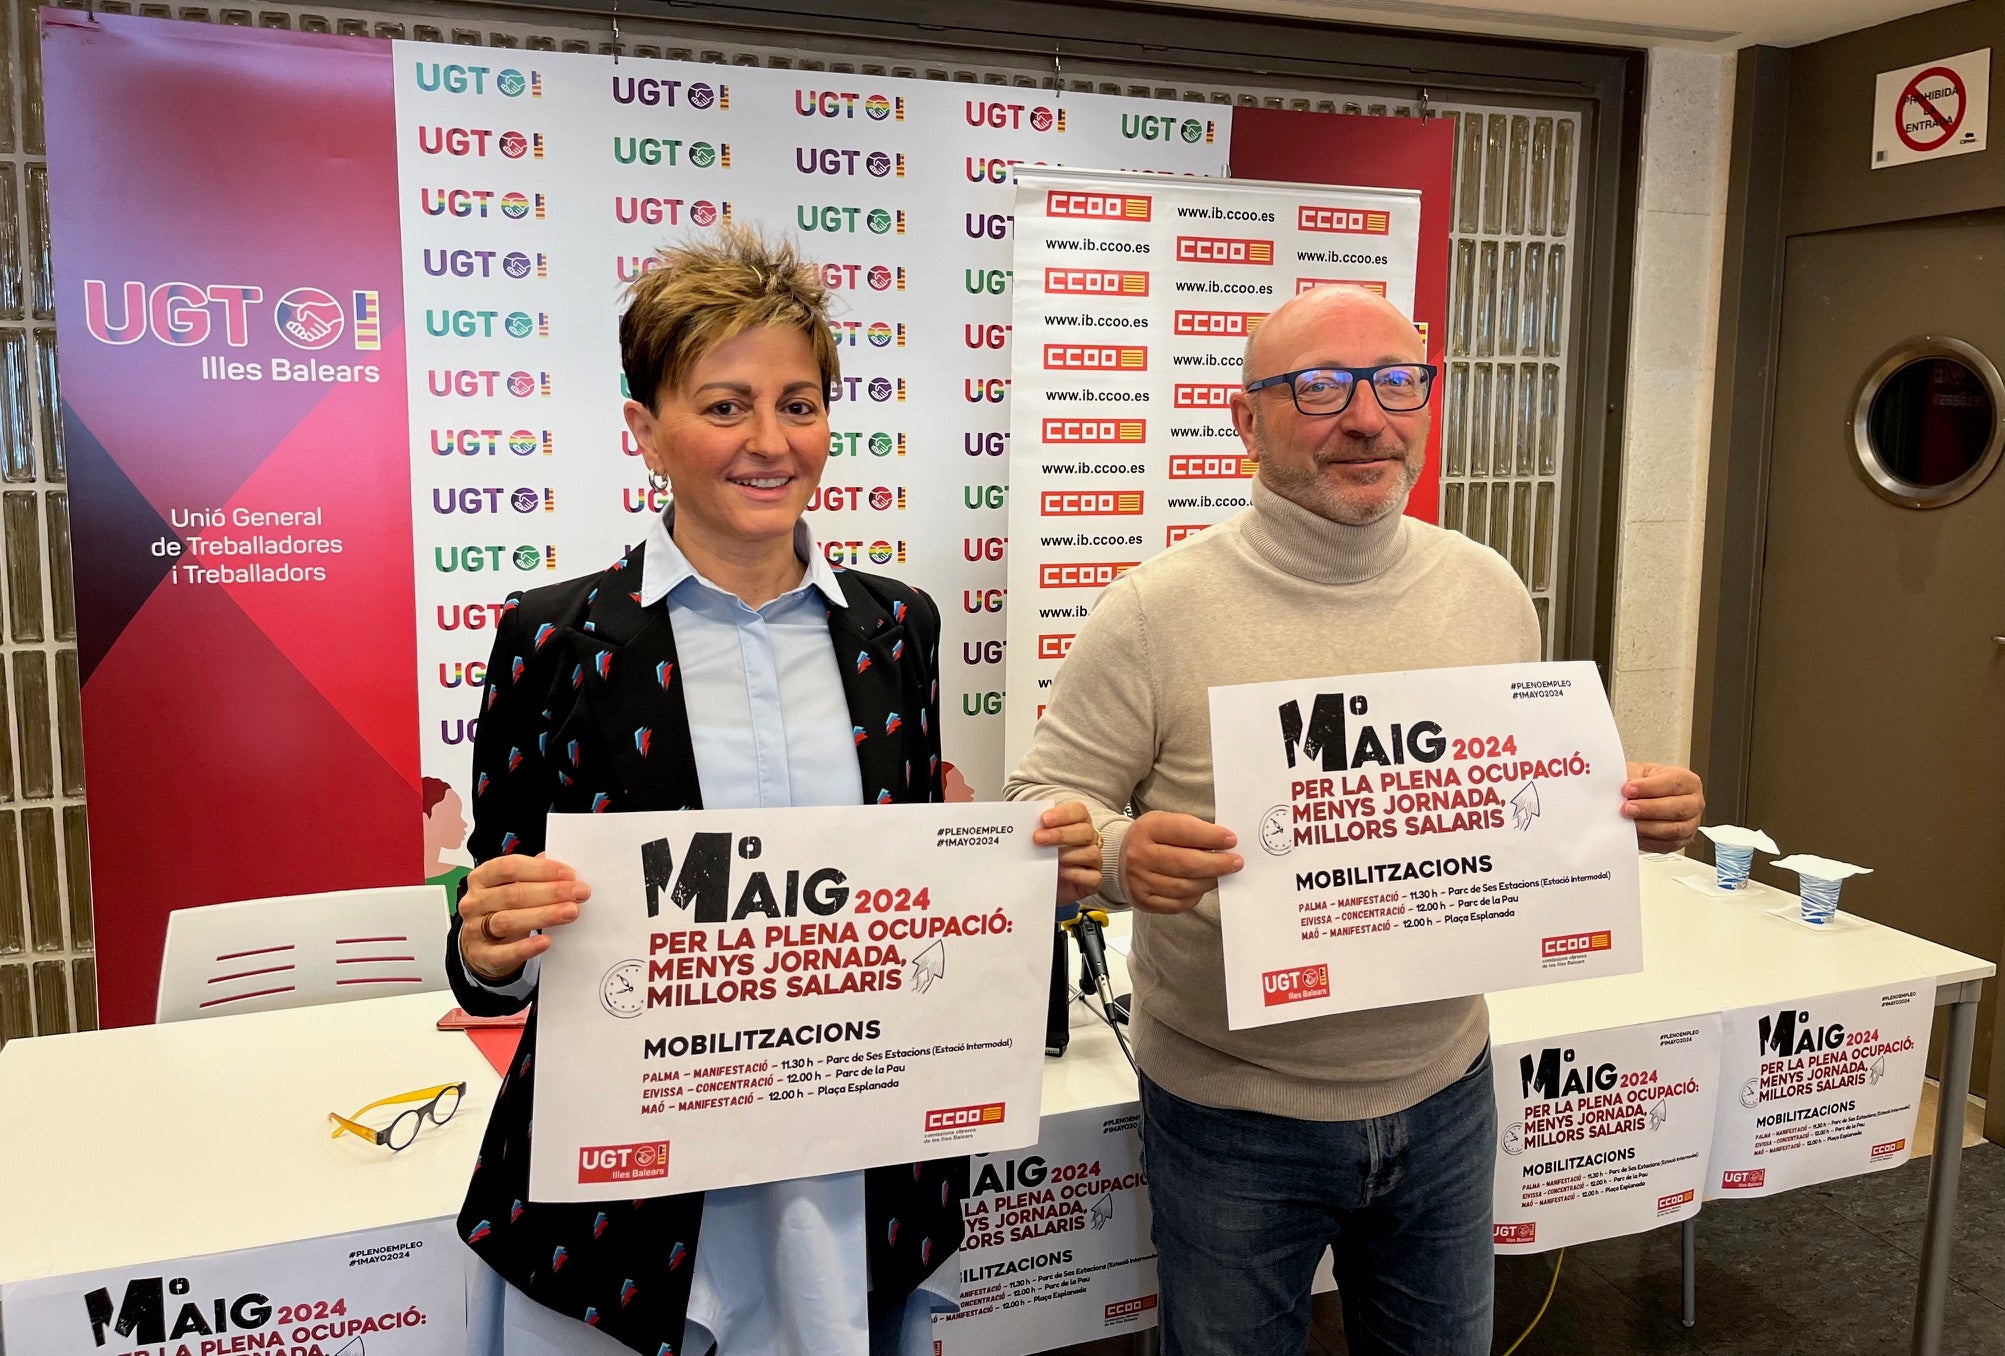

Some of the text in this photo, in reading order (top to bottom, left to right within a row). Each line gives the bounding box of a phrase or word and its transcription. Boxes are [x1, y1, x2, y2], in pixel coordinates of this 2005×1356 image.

[416, 62, 490, 94] UGT
[613, 77, 681, 106] UGT
[796, 90, 859, 118] UGT
[966, 101, 1025, 129] UGT
[1122, 114, 1176, 141] UGT
[419, 126, 492, 156] UGT
[615, 137, 682, 166] UGT
[797, 148, 860, 175] UGT
[422, 188, 494, 217] UGT
[616, 197, 684, 225] UGT
[1051, 195, 1121, 215] CCOO
[1178, 207, 1274, 222] www.ib.ccoo.es
[798, 205, 861, 233] UGT
[1302, 210, 1363, 229] CCOO
[1046, 239, 1150, 253] www.ib.ccoo.es
[1181, 240, 1245, 259] CCOO
[1297, 251, 1387, 264] www.ib.ccoo.es
[424, 249, 496, 277] UGT
[1049, 272, 1119, 291] CCOO
[1176, 281, 1272, 294] www.ib.ccoo.es
[84, 280, 263, 347] UGT
[426, 310, 498, 337] UGT
[1045, 314, 1148, 327] www.ib.ccoo.es
[1178, 314, 1242, 332] CCOO
[203, 356, 380, 383] Illes Balears
[1048, 349, 1116, 366] CCOO
[429, 370, 500, 397] UGT
[1046, 389, 1149, 401] www.ib.ccoo.es
[431, 430, 502, 456] UGT
[1047, 423, 1115, 439] CCOO
[1042, 462, 1145, 473] www.ib.ccoo.es
[1173, 459, 1236, 475] CCOO
[433, 488, 504, 514] UGT
[1045, 495, 1113, 511] CCOO
[171, 507, 321, 528] Unió General
[151, 535, 342, 557] de Treballadores
[1041, 534, 1142, 546] www.ib.ccoo.es
[435, 546, 506, 572] UGT
[172, 564, 326, 584] i Treballadors
[1044, 567, 1115, 586] CCOO
[1511, 680, 1571, 689] #PLENOEMPLEO
[1512, 689, 1563, 699] #1MAYO2024
[1452, 734, 1517, 760] 2024
[1291, 751, 1590, 801] PER LA PLENA OCUPACIÓ:
[1292, 786, 1505, 823] MENYS JORNADA,
[937, 825, 1013, 835] #PLENOEMPLEO
[1293, 808, 1504, 846] MILLORS SALARIS
[937, 836, 998, 846] #1MAYO2024
[1296, 855, 1492, 891] MOBILITZACIONS
[854, 887, 930, 913] 2024
[1299, 901, 1327, 912] PALMA
[1338, 891, 1398, 907] MANIFESTACIÓ
[1448, 887, 1468, 895] Parc
[1470, 884, 1480, 893] de
[1482, 883, 1497, 892] Ses
[1499, 879, 1539, 890] Estacions
[1540, 876, 1569, 887] (Estació
[1571, 871, 1610, 882] Intermodal)
[1301, 895, 1518, 926] EIVISSA CONCENTRACIÓ 12.00 Parc de la Pau
[649, 907, 1012, 955] PER LA PLENA OCUPACIÓ:
[1301, 908, 1514, 940] MAÓ MANIFESTACIÓ 12.00 Plaça Esplanada
[1544, 937, 1590, 953] CCOO
[648, 944, 906, 982] MENYS JORNADA,
[647, 968, 901, 1008] MILLORS SALARIS
[1265, 971, 1300, 993] UGT
[1303, 988, 1327, 998] Balears
[644, 1020, 880, 1059] MOBILITZACIONS
[1846, 1029, 1878, 1046] 2024
[643, 1071, 679, 1082] PALMA
[693, 1059, 767, 1078] MANIFESTACIÓ
[826, 1055, 849, 1064] Parc
[851, 1052, 863, 1062] de
[866, 1051, 882, 1060] Ses
[885, 1047, 930, 1059] Estacions
[932, 1043, 964, 1055] (Estació
[966, 1038, 1012, 1050] Intermodal)
[1761, 1037, 1913, 1075] PER LA PLENA OCUPACIÓ:
[643, 1064, 905, 1098] EIVISSA CONCENTRACIÓ 12.00 Parc de la Pau
[1619, 1069, 1657, 1087] 2024
[1759, 1073, 1865, 1102] MILLORS SALARIS
[1760, 1060, 1868, 1089] MENYS JORNADA,
[641, 1078, 898, 1114] MAÓ MANIFESTACIÓ 12.00 Plaça Esplanada
[1525, 1077, 1698, 1119] PER LA PLENA OCUPACIÓ:
[928, 1110, 980, 1127] CCOO
[1524, 1103, 1648, 1134] MENYS JORNADA,
[1756, 1100, 1855, 1128] MOBILITZACIONS
[1524, 1117, 1645, 1149] MILLORS SALARIS
[582, 1149, 631, 1170] UGT
[1051, 1160, 1100, 1183] 2024
[1523, 1147, 1635, 1177] MOBILITZACIONS
[613, 1168, 664, 1179] Illes Balears
[965, 1188, 1055, 1217] LA PLENA
[995, 1201, 1087, 1229] JORNADA,
[1010, 1215, 1085, 1242] SALARIS
[349, 1241, 422, 1258] #PLENOEMPLEO
[349, 1251, 409, 1266] #1MAYO2024
[277, 1298, 346, 1324] 2024
[201, 1332, 284, 1356] PLENA
[292, 1306, 426, 1344] OCUPACIÓ:
